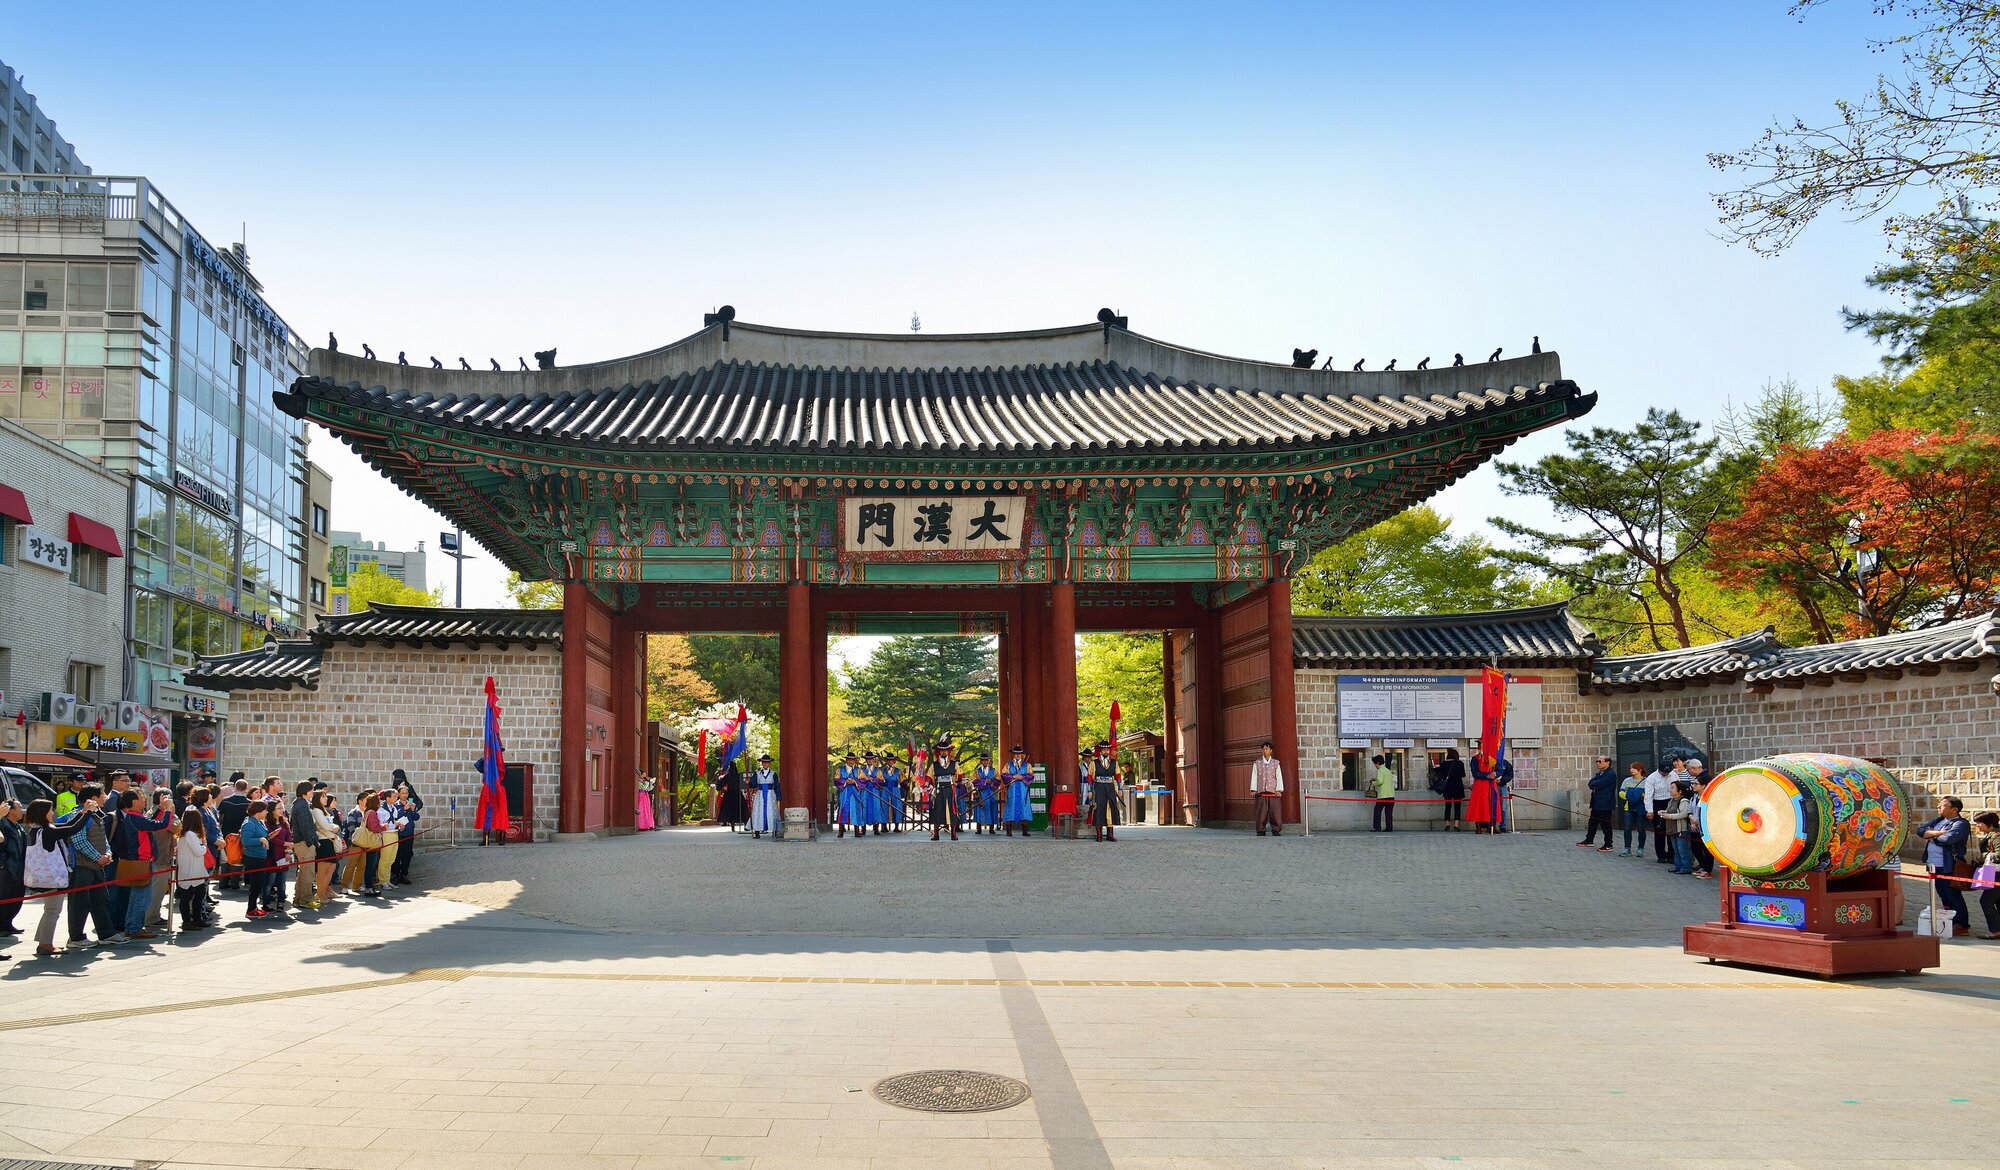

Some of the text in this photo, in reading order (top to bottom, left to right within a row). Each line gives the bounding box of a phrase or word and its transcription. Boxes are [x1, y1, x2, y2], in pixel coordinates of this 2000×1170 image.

[33, 378, 51, 399] 핫
[67, 379, 103, 396] 요가
[177, 471, 233, 516] DESIGN FITNESS
